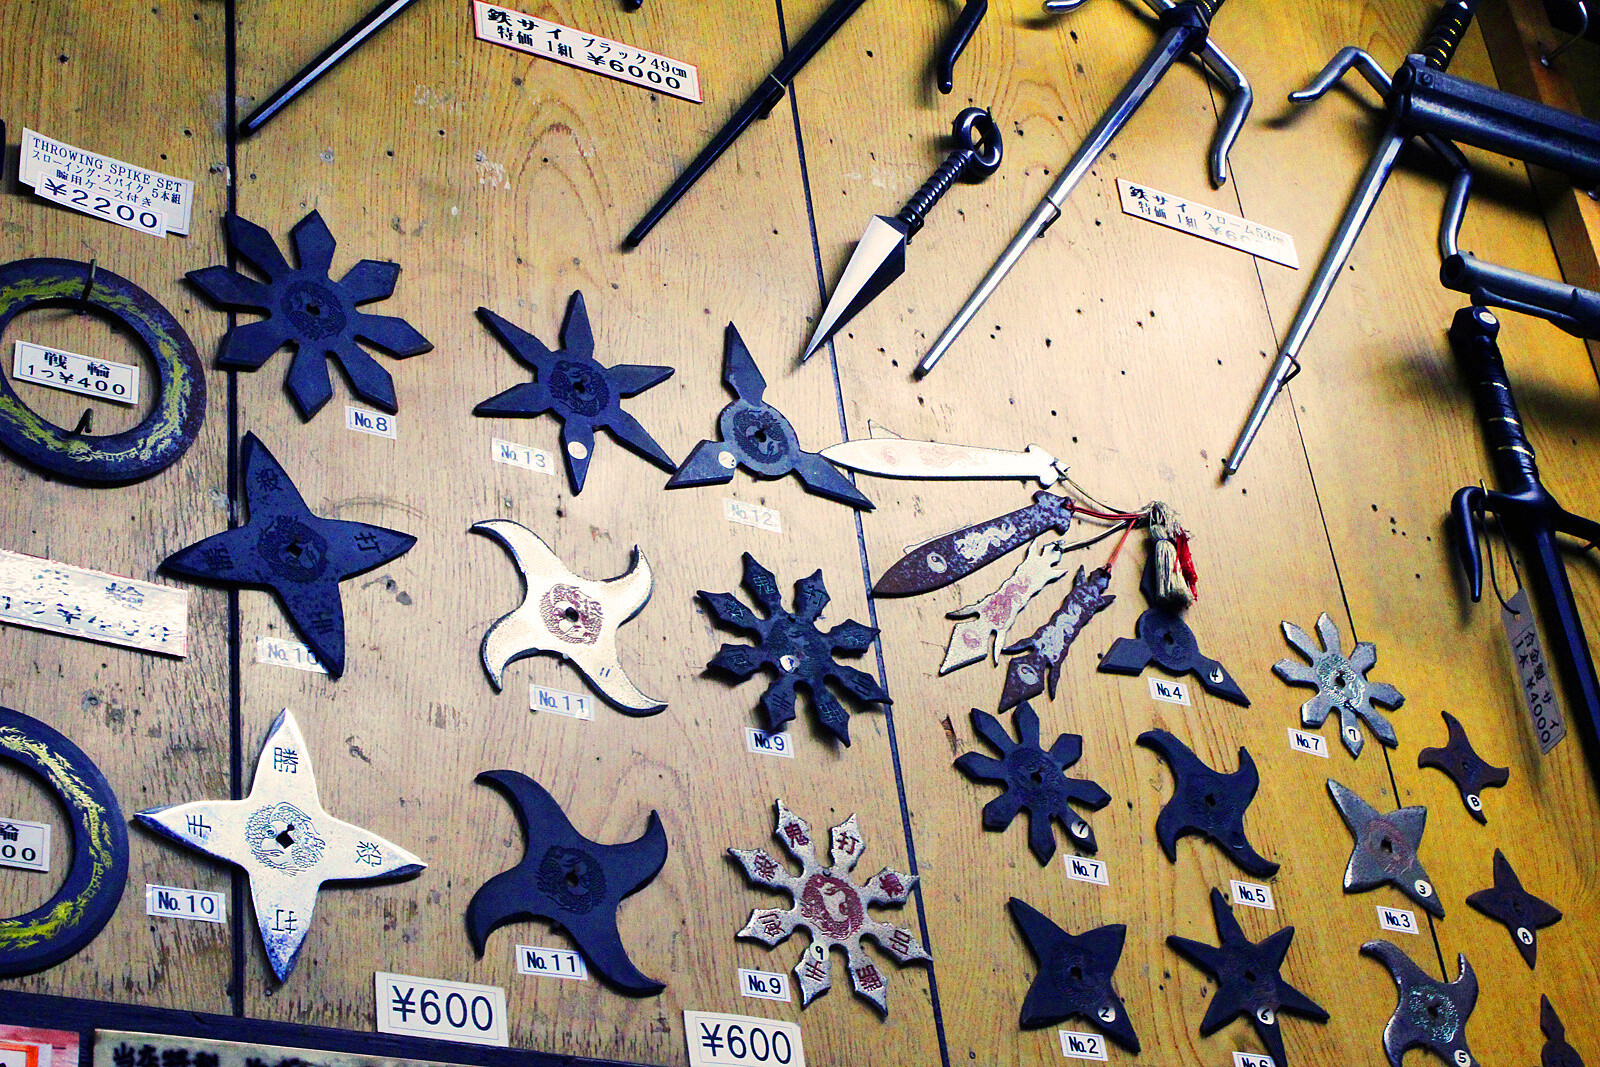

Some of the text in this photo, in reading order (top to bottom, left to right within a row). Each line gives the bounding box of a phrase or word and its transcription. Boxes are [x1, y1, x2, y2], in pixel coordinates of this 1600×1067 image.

[497, 26, 533, 47] 特価
[587, 52, 681, 90] ¥6000
[33, 138, 182, 192] THROWING SPIKE SET
[44, 178, 158, 228] ¥2200
[354, 411, 388, 432] No.8
[1211, 668, 1220, 681] 4
[1157, 682, 1182, 699] No.4
[754, 733, 785, 751] No.9
[1296, 734, 1320, 750] No.7
[1348, 728, 1357, 741] 7
[274, 747, 298, 774] 勝
[1470, 796, 1480, 807] B
[1077, 821, 1088, 835] 7
[1073, 861, 1099, 878] No.7
[1239, 886, 1266, 903] No.5
[1419, 885, 1427, 894] 3
[158, 891, 215, 914] No.10
[1385, 912, 1410, 928] No.3
[1521, 931, 1530, 942] A
[815, 945, 824, 960] 9
[526, 951, 576, 972] No.11
[748, 975, 781, 994] No.9
[392, 984, 494, 1031] ¥600
[1101, 1006, 1111, 1018] 2
[1261, 1008, 1270, 1021] 6
[701, 1022, 793, 1065] ¥600
[1068, 1036, 1099, 1054] No.2
[1458, 1053, 1467, 1064] 5
